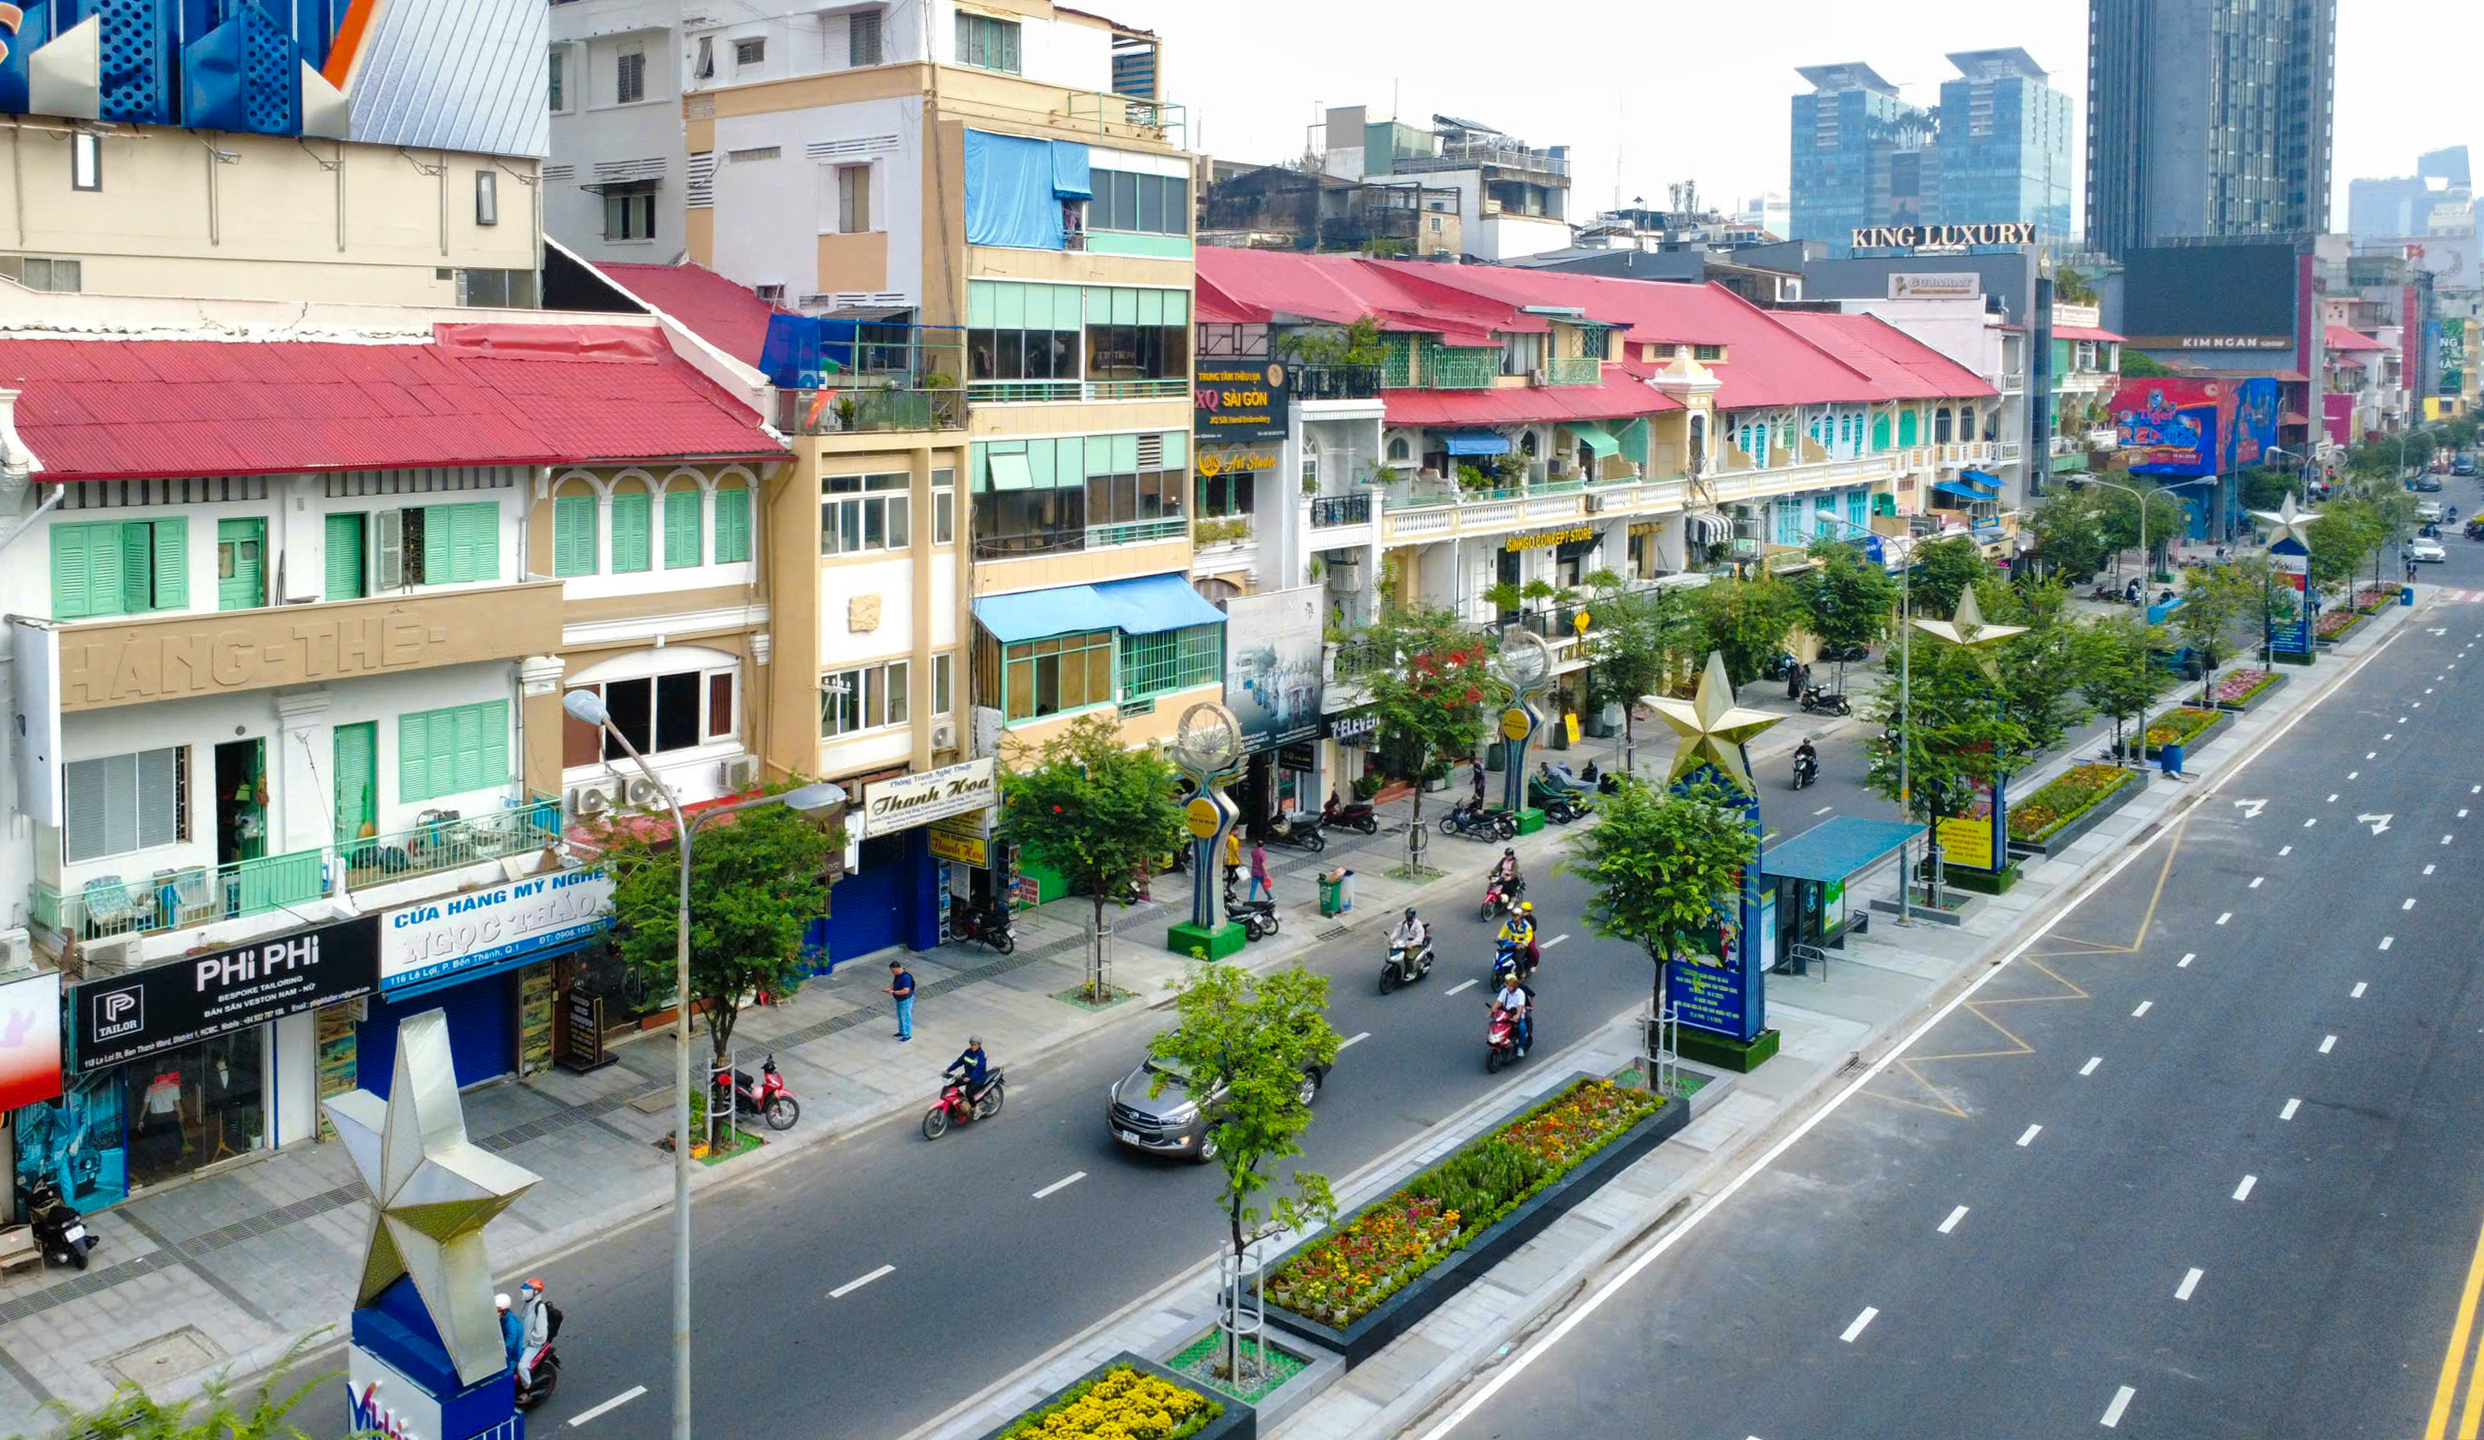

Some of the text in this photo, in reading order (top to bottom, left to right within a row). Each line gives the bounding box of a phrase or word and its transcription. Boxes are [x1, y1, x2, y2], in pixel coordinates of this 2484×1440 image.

[1851, 223, 2035, 248] KING LUXURY
[2183, 338, 2210, 347] KIM
[2214, 338, 2258, 347] NGAN
[1195, 389, 1219, 412] XQ
[1570, 527, 1593, 543] STORE
[871, 786, 940, 816] Thanh
[946, 777, 990, 797] Hoa
[394, 905, 440, 929] CỬA
[448, 890, 507, 916] HÀNG
[514, 878, 546, 899] MỸ
[403, 914, 502, 965] NGỌC
[390, 974, 407, 985] 116
[409, 970, 421, 981] Lê
[453, 956, 471, 969] Bến
[218, 974, 303, 1003] BESPOKE TAILORING
[244, 992, 277, 1008] VESTON
[278, 987, 296, 999] NAM
[99, 1020, 137, 1037] TAILOR
